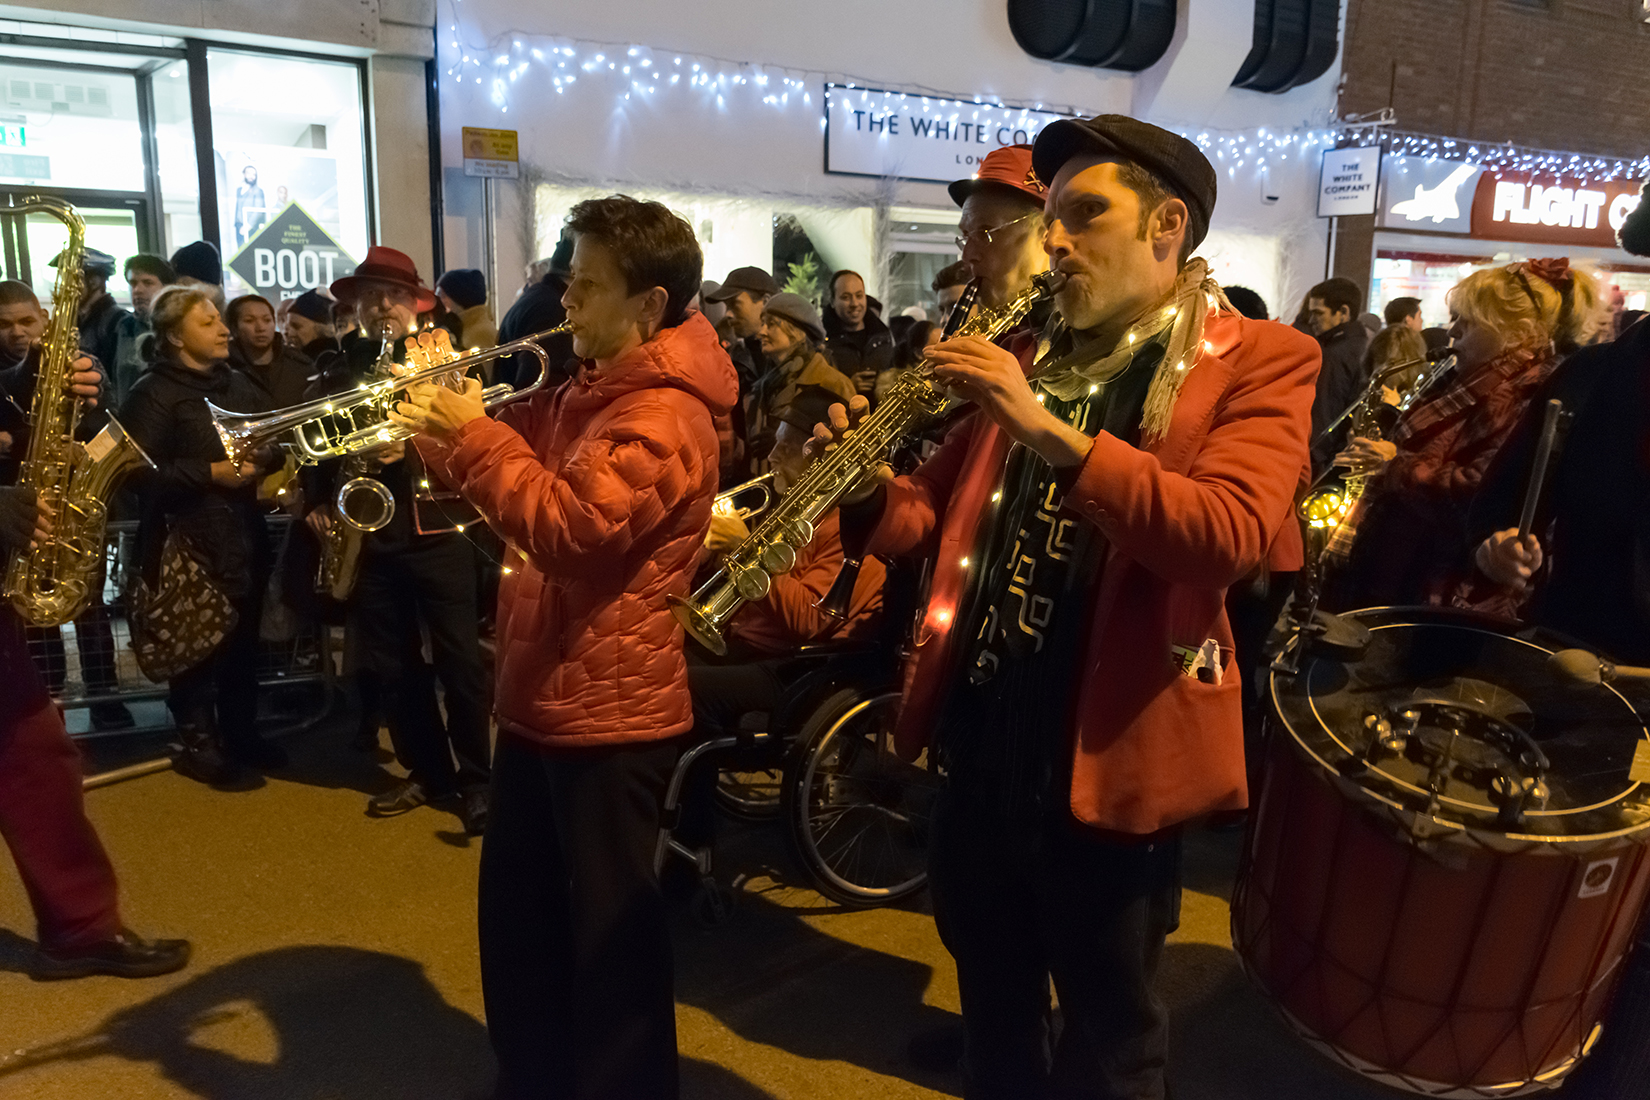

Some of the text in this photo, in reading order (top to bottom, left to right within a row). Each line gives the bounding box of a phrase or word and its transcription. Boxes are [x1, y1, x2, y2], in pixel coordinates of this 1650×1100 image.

[854, 110, 1037, 146] THE WHITE CO
[1342, 163, 1359, 171] THE
[1333, 174, 1363, 182] WHITE
[1324, 184, 1371, 194] COMPANY
[1493, 181, 1606, 229] FLIGHT
[281, 237, 309, 245] QUALITY
[254, 248, 338, 290] BOOT
